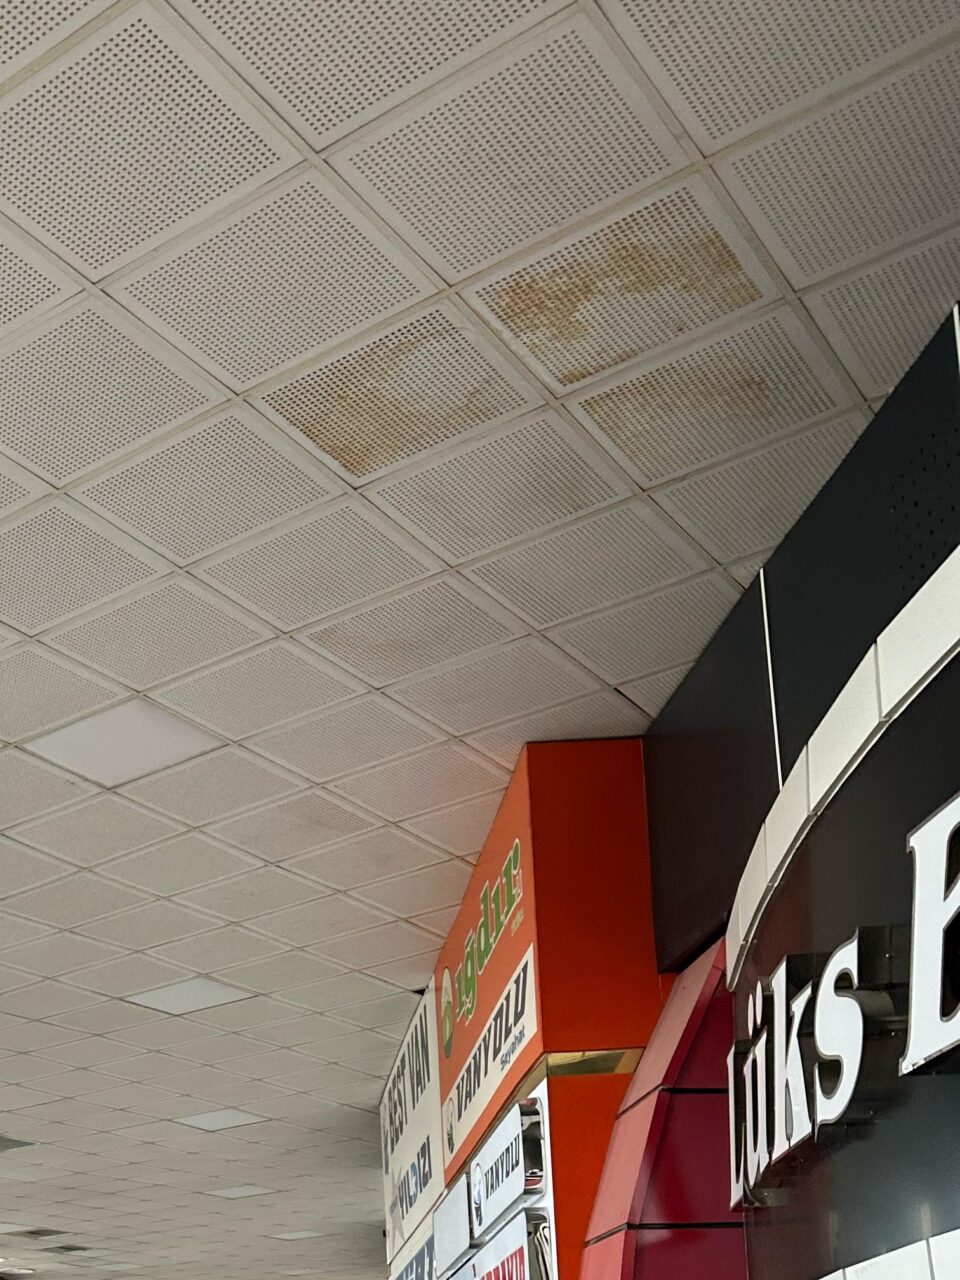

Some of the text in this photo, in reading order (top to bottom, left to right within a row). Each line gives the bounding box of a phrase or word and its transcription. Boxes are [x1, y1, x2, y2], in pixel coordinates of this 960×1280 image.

[389, 1003, 430, 1154] BEST VAN
[455, 960, 528, 1122] VANYOLU
[500, 1024, 525, 1073] Seyahat
[484, 1133, 520, 1200] VANYOLU
